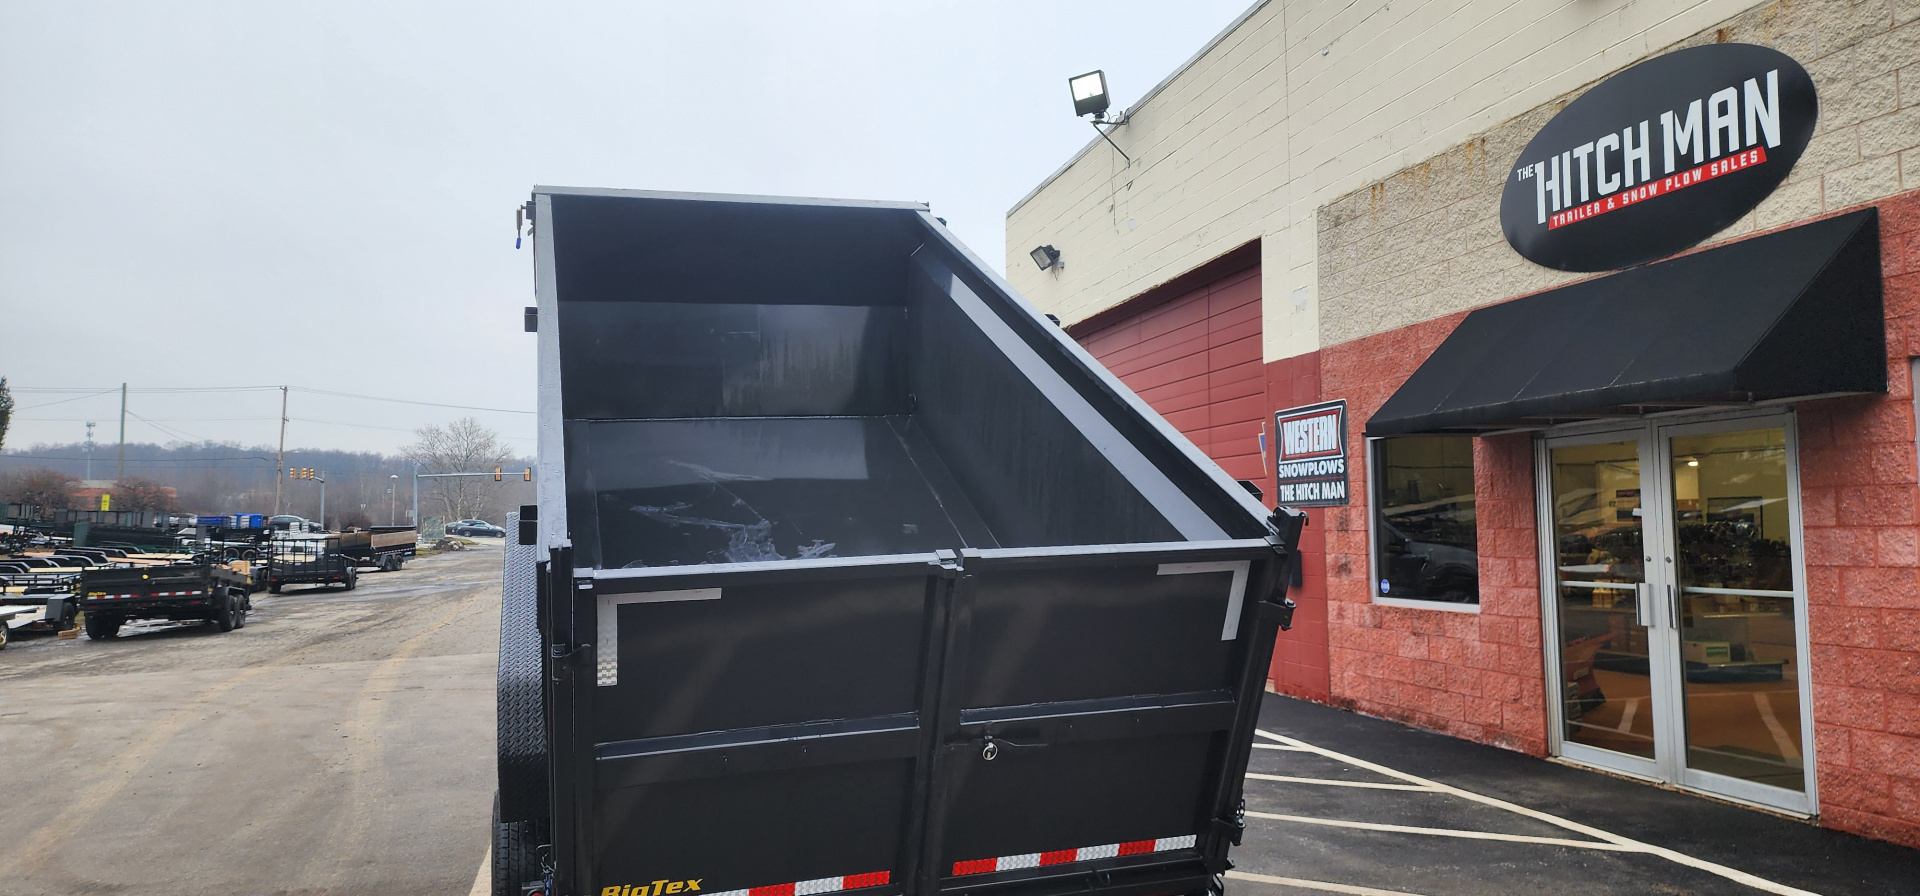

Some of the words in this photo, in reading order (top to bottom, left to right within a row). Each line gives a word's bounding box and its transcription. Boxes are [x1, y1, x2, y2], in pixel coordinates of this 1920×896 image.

[1517, 163, 1534, 182] THE
[1534, 119, 1651, 225] HITCH
[1660, 68, 1781, 174] MAN
[1552, 201, 1601, 227] TRAILER
[1607, 197, 1615, 209] &
[1622, 182, 1658, 204] SNOW
[1665, 168, 1702, 191] PLOW
[1711, 149, 1758, 176] SALES
[1283, 414, 1337, 455] WESTERN
[1278, 459, 1345, 479] SNOWPLOWS
[1280, 484, 1295, 502] THE
[1296, 482, 1320, 501] HITCH
[1321, 480, 1346, 500] MAN
